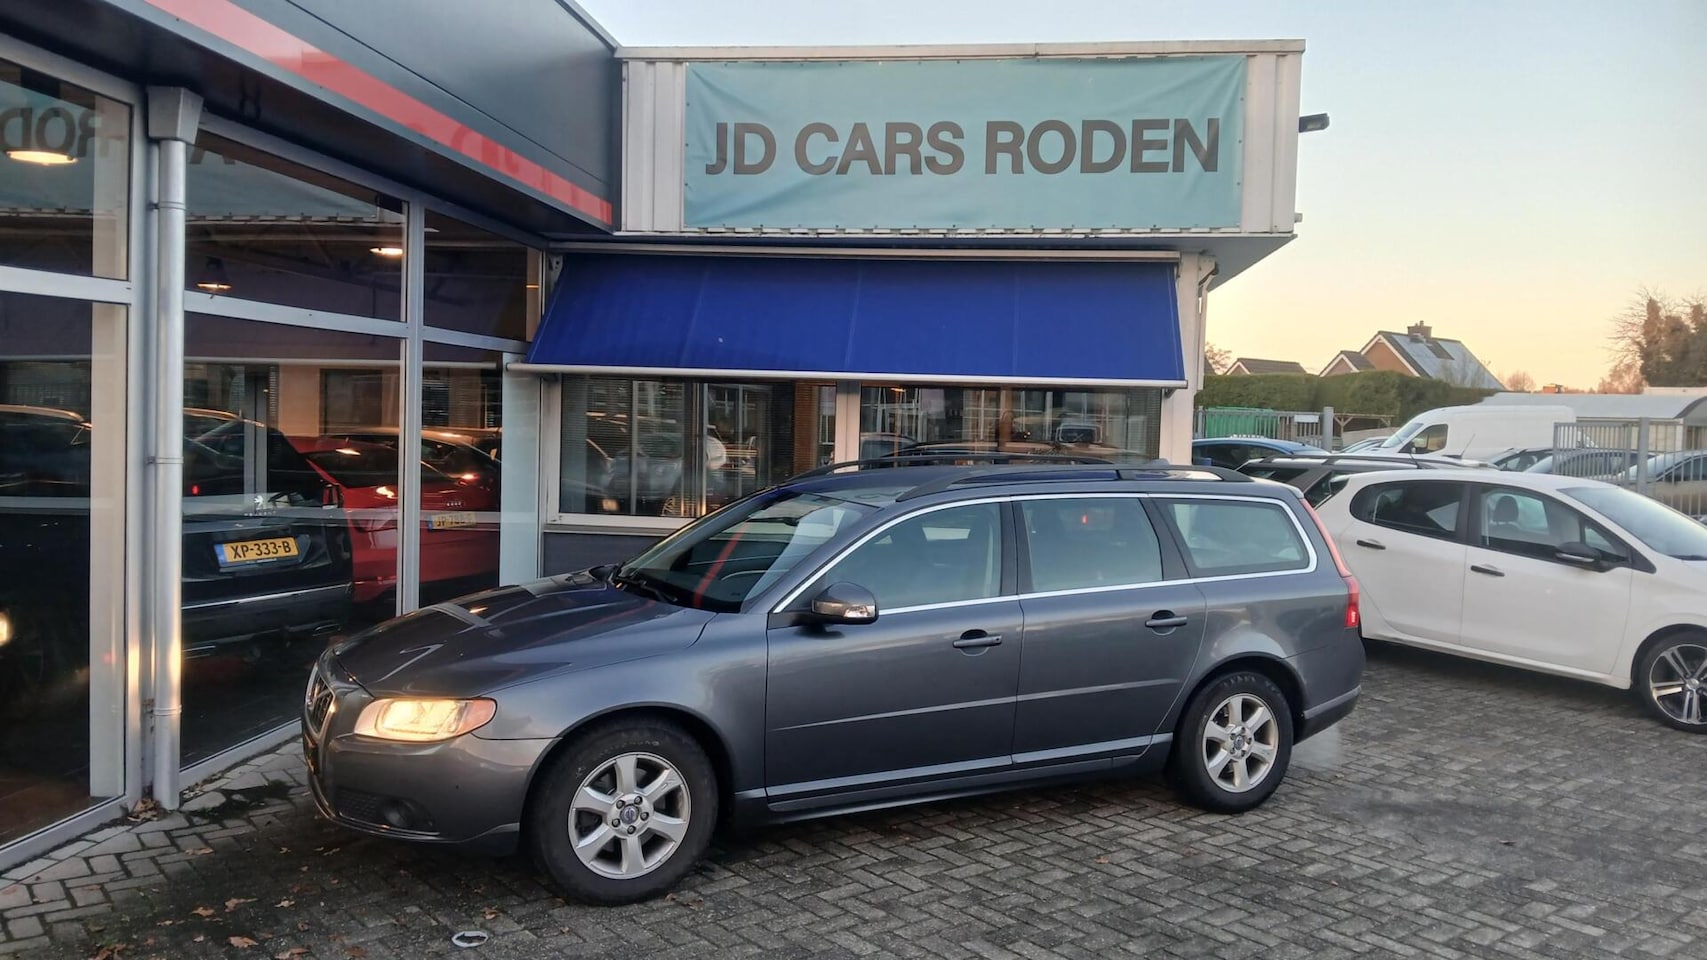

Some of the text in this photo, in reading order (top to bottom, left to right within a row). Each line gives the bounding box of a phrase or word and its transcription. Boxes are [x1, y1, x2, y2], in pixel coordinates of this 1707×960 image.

[705, 118, 1220, 176] JD CARS RODEN
[230, 540, 292, 559] XP-333-B
